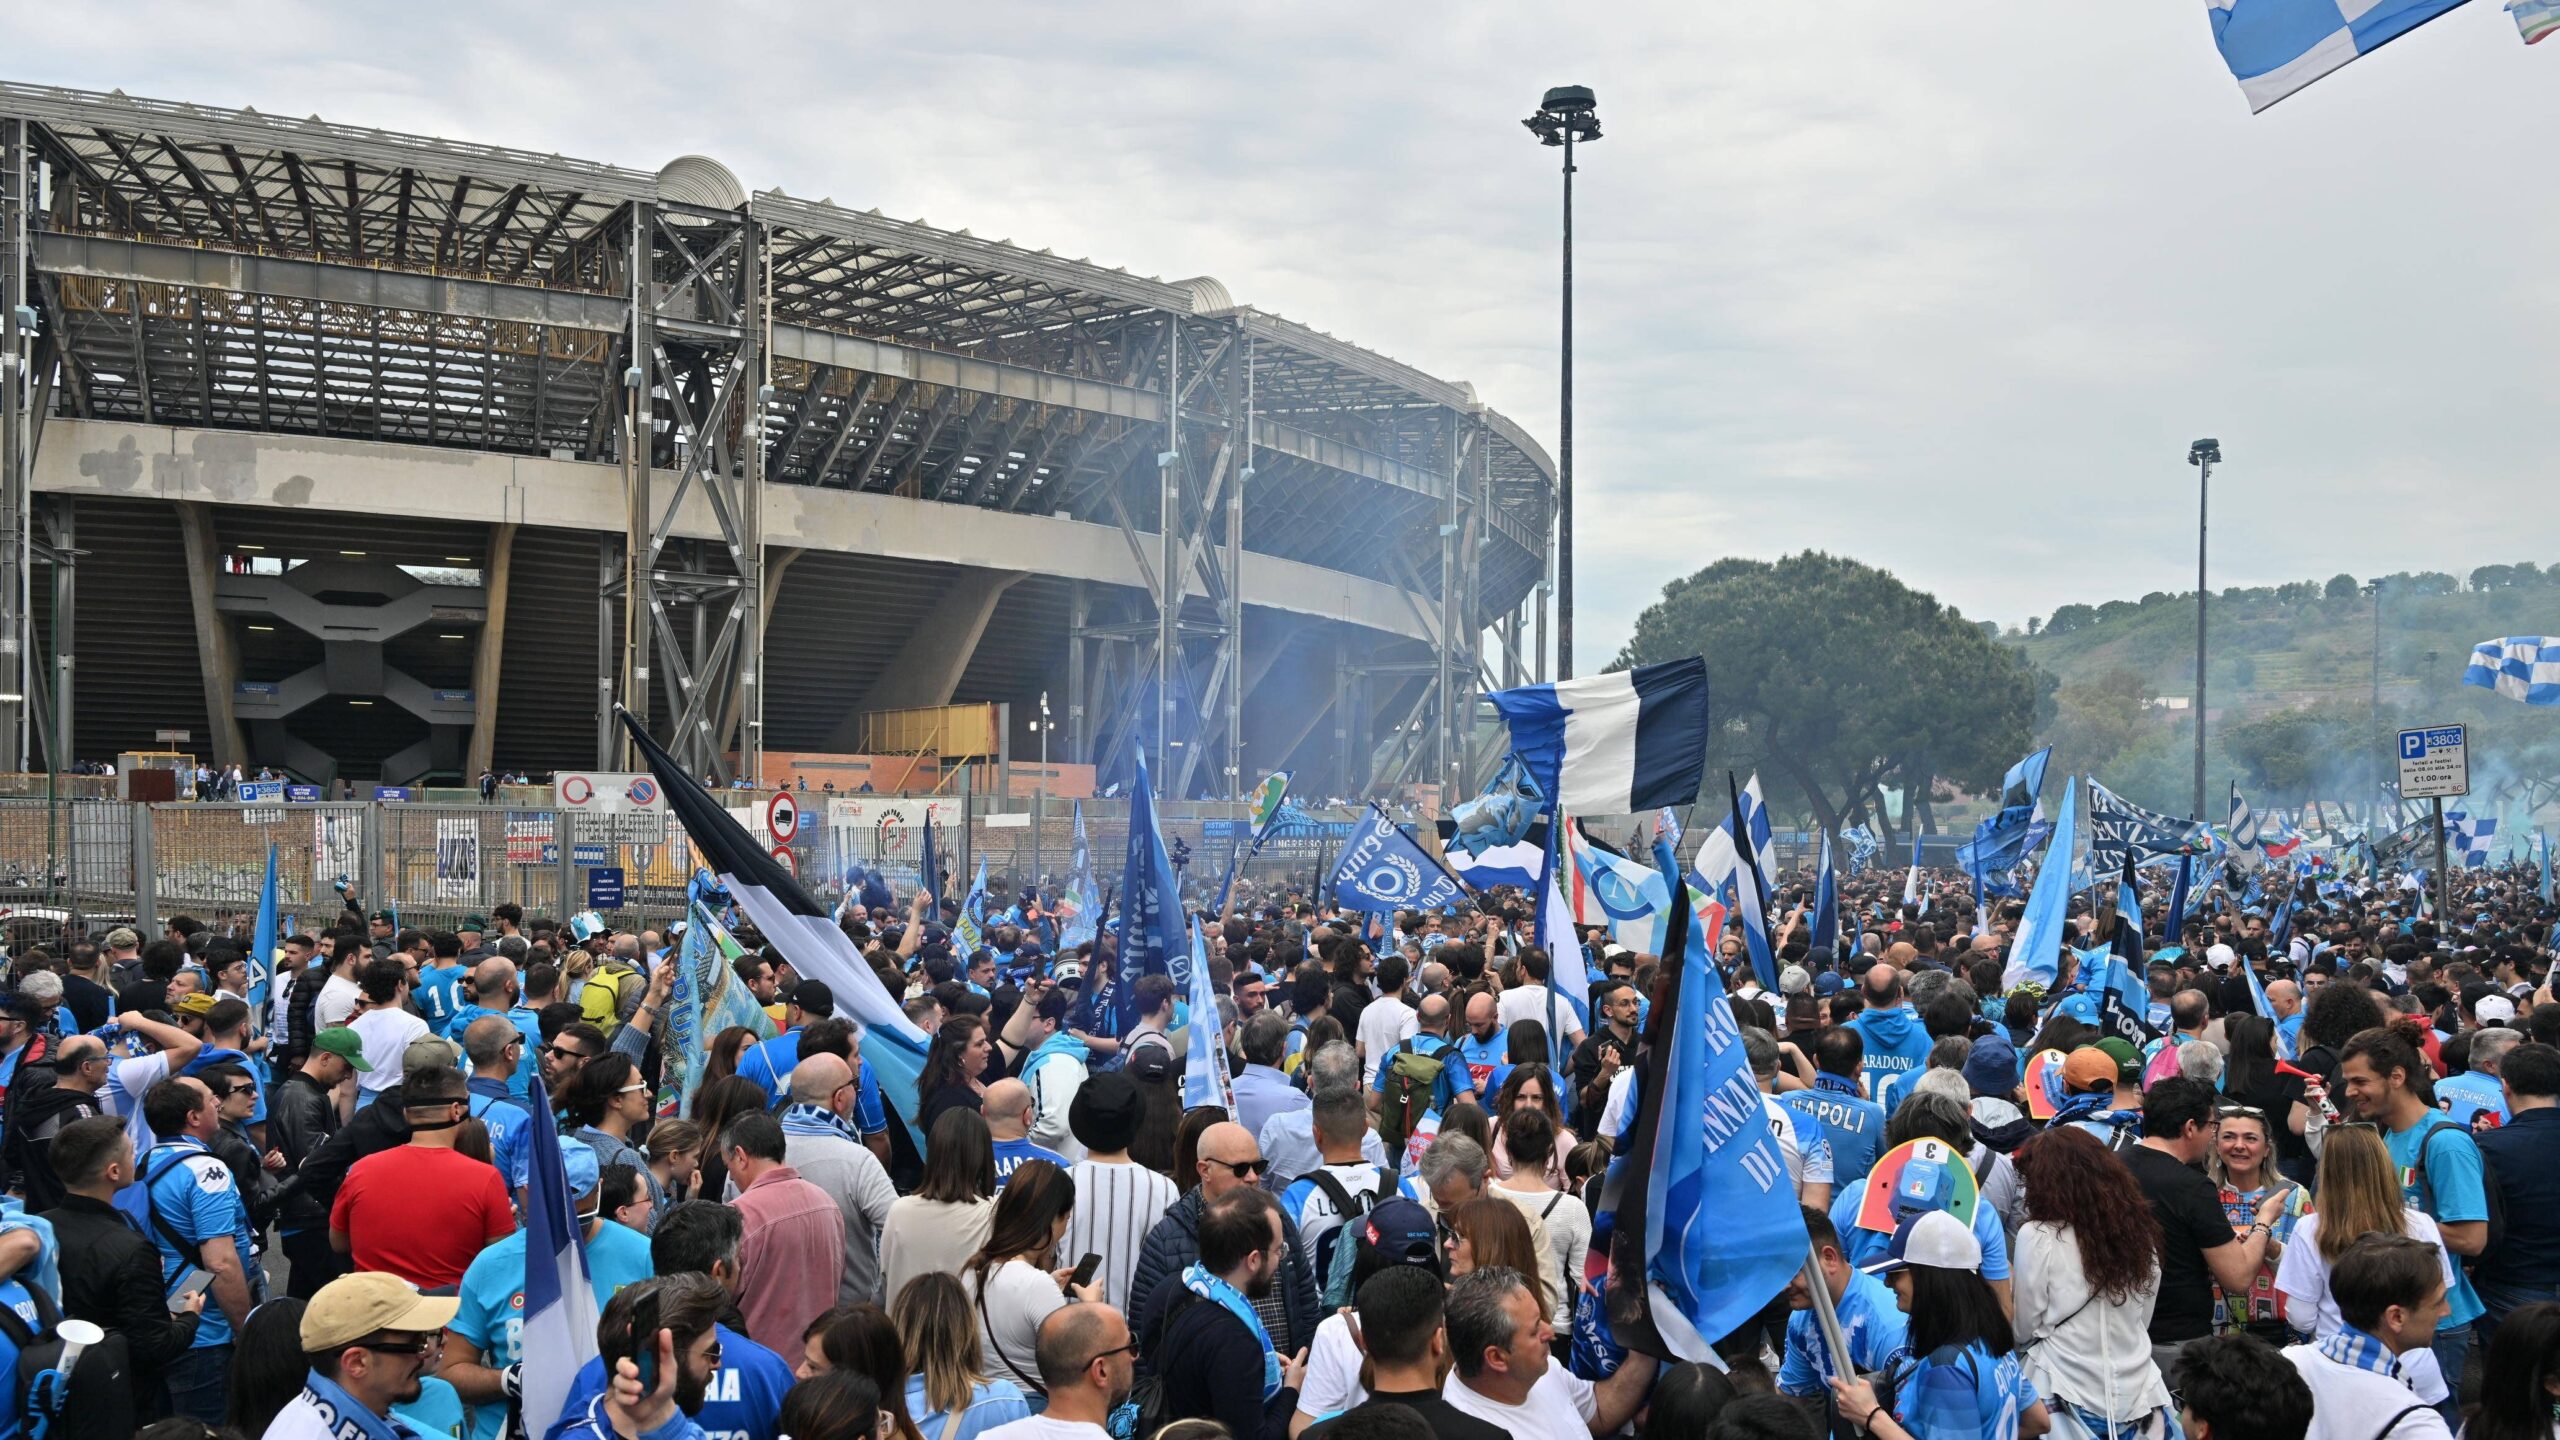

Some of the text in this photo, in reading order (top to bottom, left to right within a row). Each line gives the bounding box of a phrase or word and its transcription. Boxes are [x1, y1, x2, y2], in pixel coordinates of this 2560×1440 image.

[2405, 734, 2461, 756] P 3803
[242, 786, 253, 799] P
[1863, 1054, 1913, 1071] ARADONA
[1791, 1099, 1865, 1134] NAPOLI
